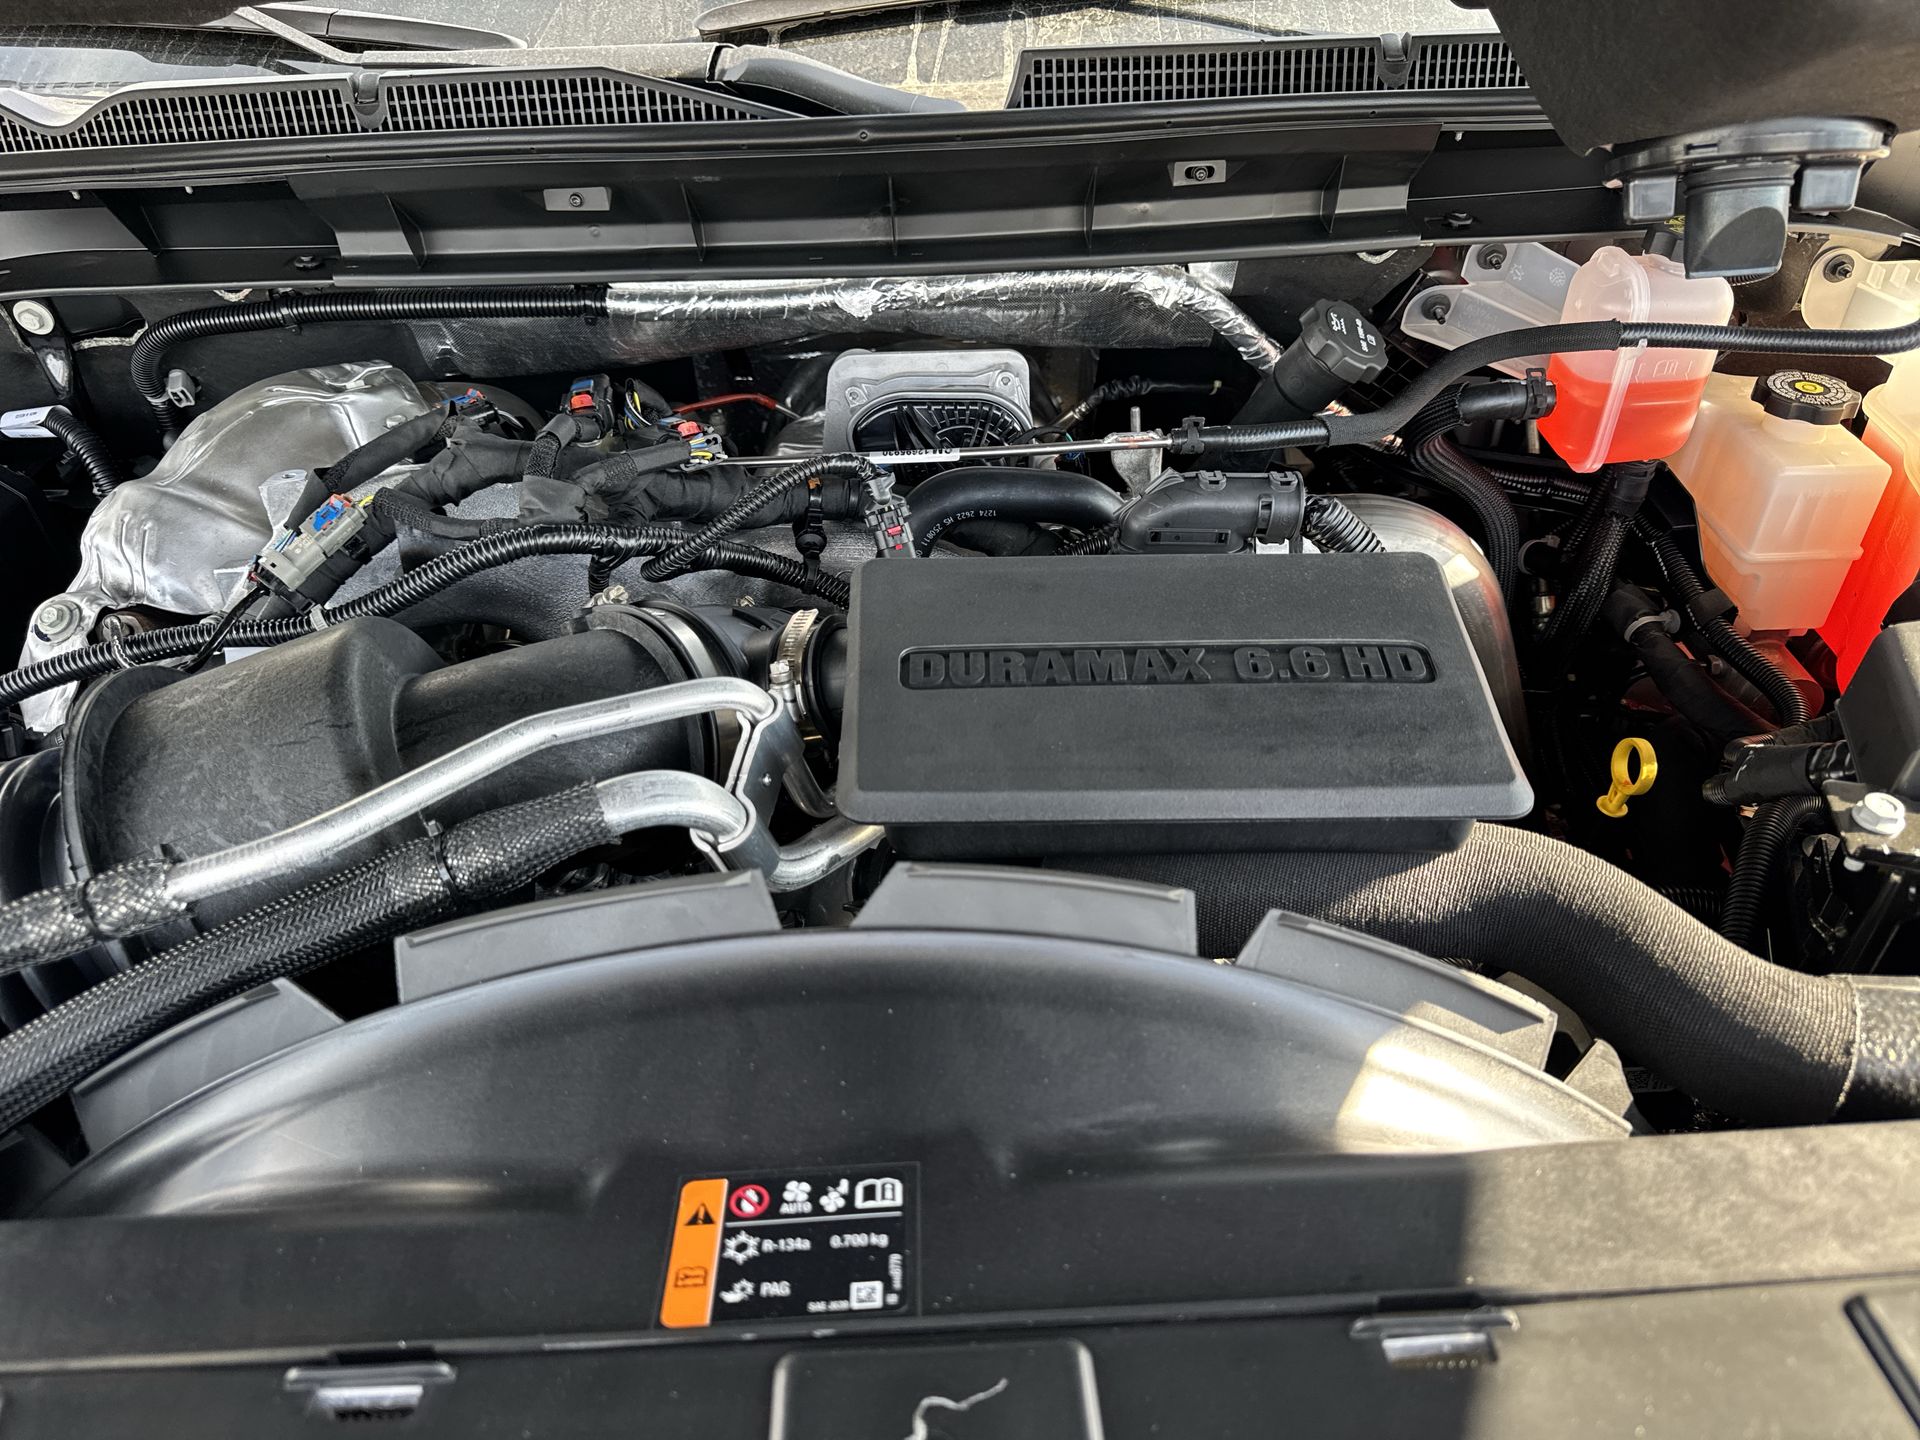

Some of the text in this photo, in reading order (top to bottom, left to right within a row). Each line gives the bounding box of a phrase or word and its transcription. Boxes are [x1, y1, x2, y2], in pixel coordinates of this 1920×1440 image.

[956, 510, 975, 521] 2622
[979, 509, 997, 517] 1274
[943, 516, 955, 526] HS
[920, 523, 943, 547] 250811
[908, 645, 1428, 686] DURAMAX 6.6 HD
[779, 1202, 813, 1215] AUTO
[761, 1232, 889, 1253] R-134a 0.700 kg
[759, 1280, 791, 1297] PAG
